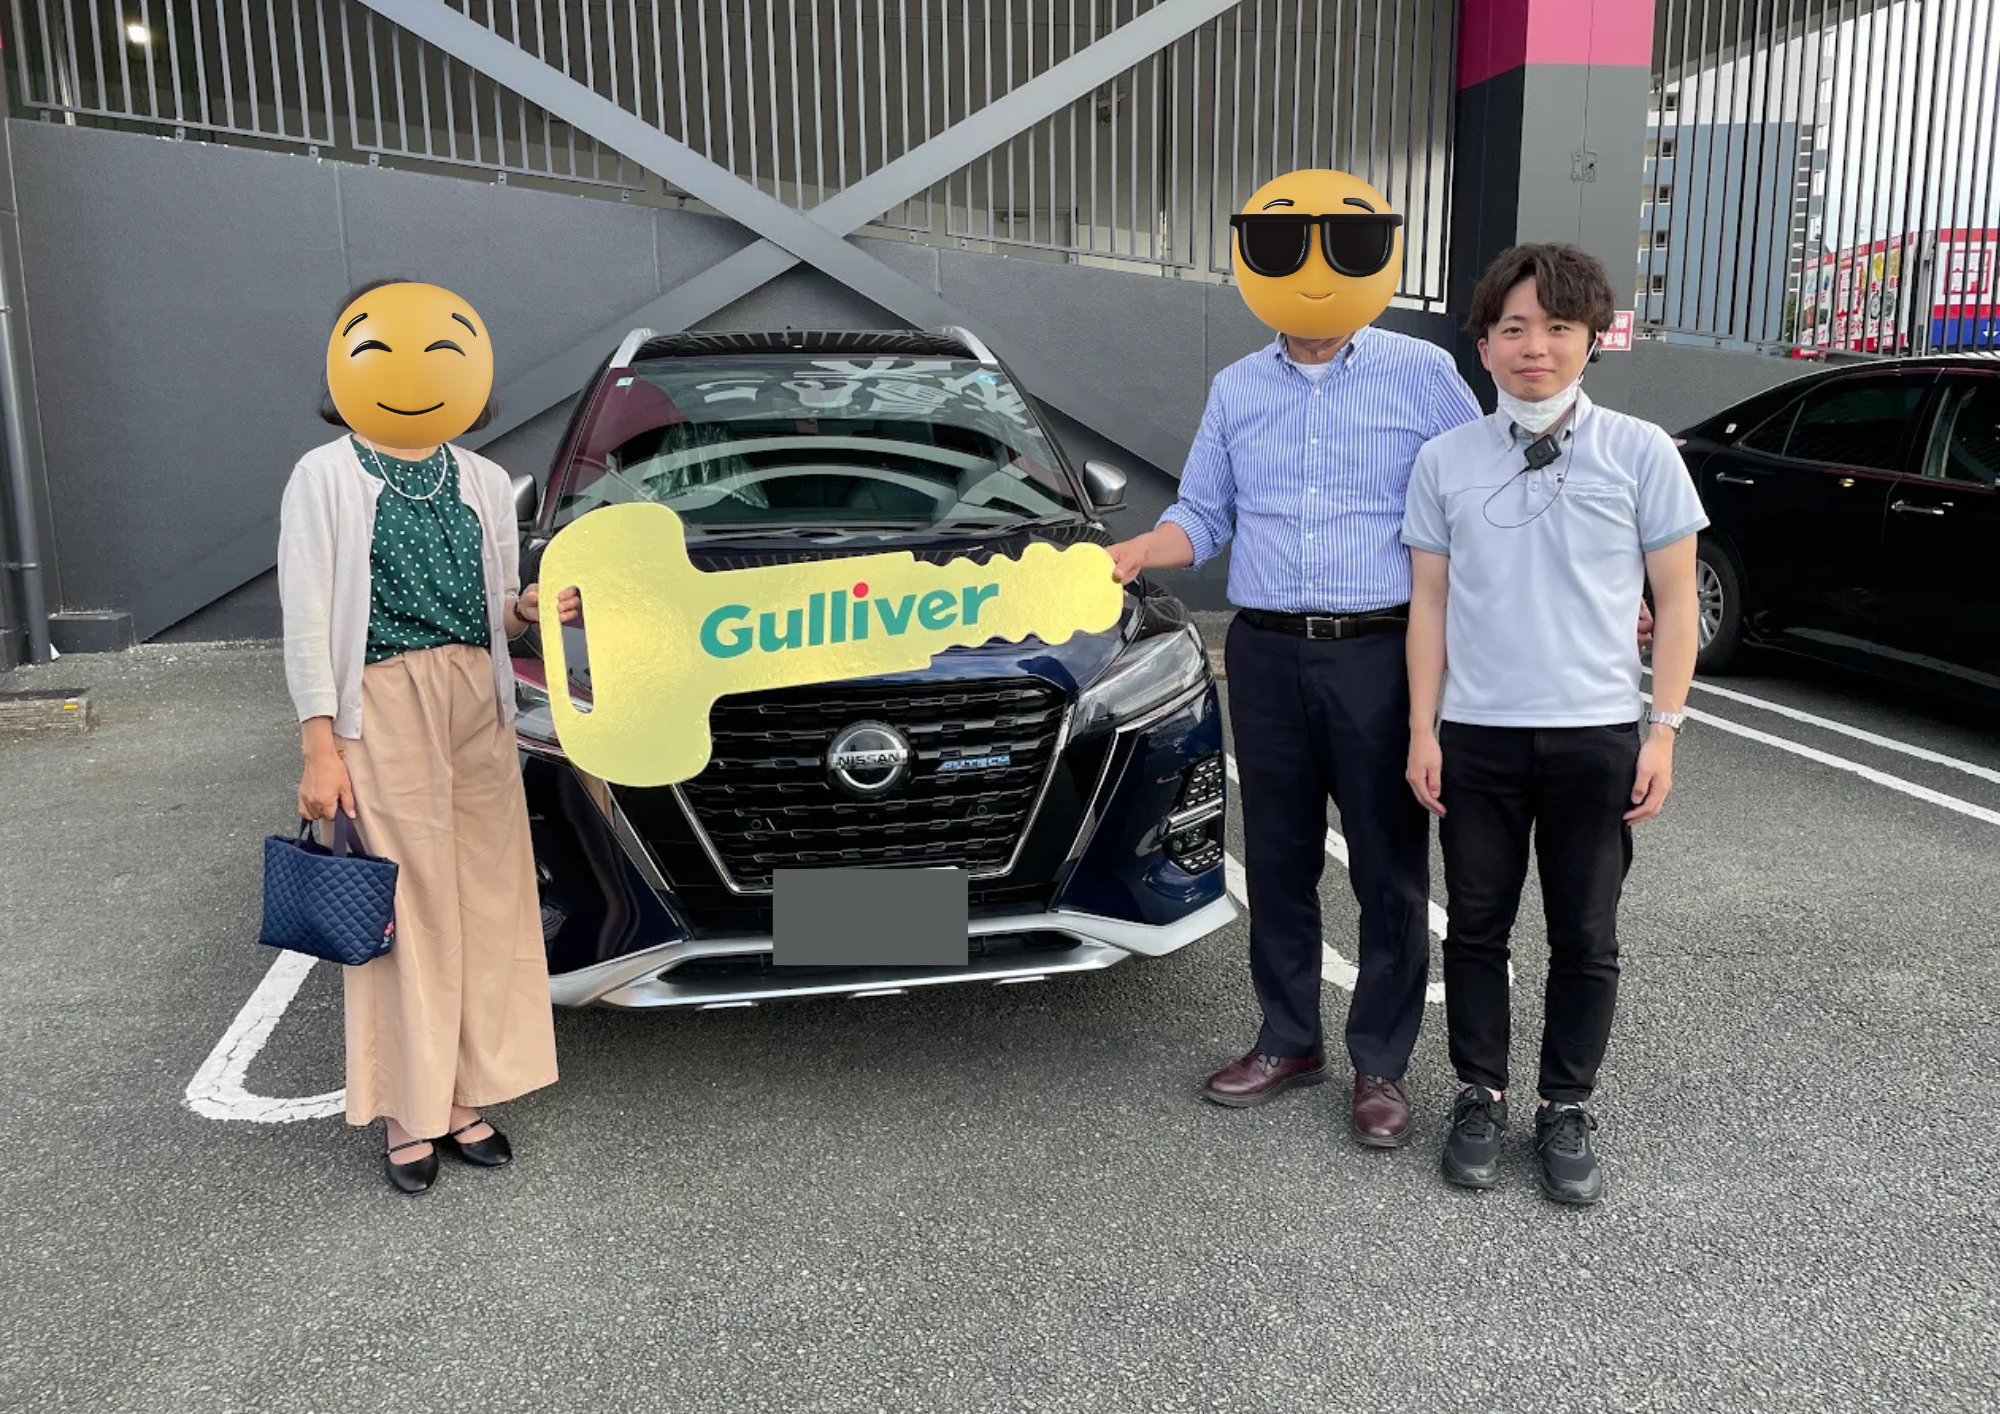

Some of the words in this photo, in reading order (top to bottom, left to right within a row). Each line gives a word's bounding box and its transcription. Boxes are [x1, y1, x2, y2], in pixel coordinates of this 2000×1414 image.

[699, 581, 1000, 659] Gulliver
[838, 753, 898, 765] NISSAN
[936, 755, 1010, 771] AUTECH
